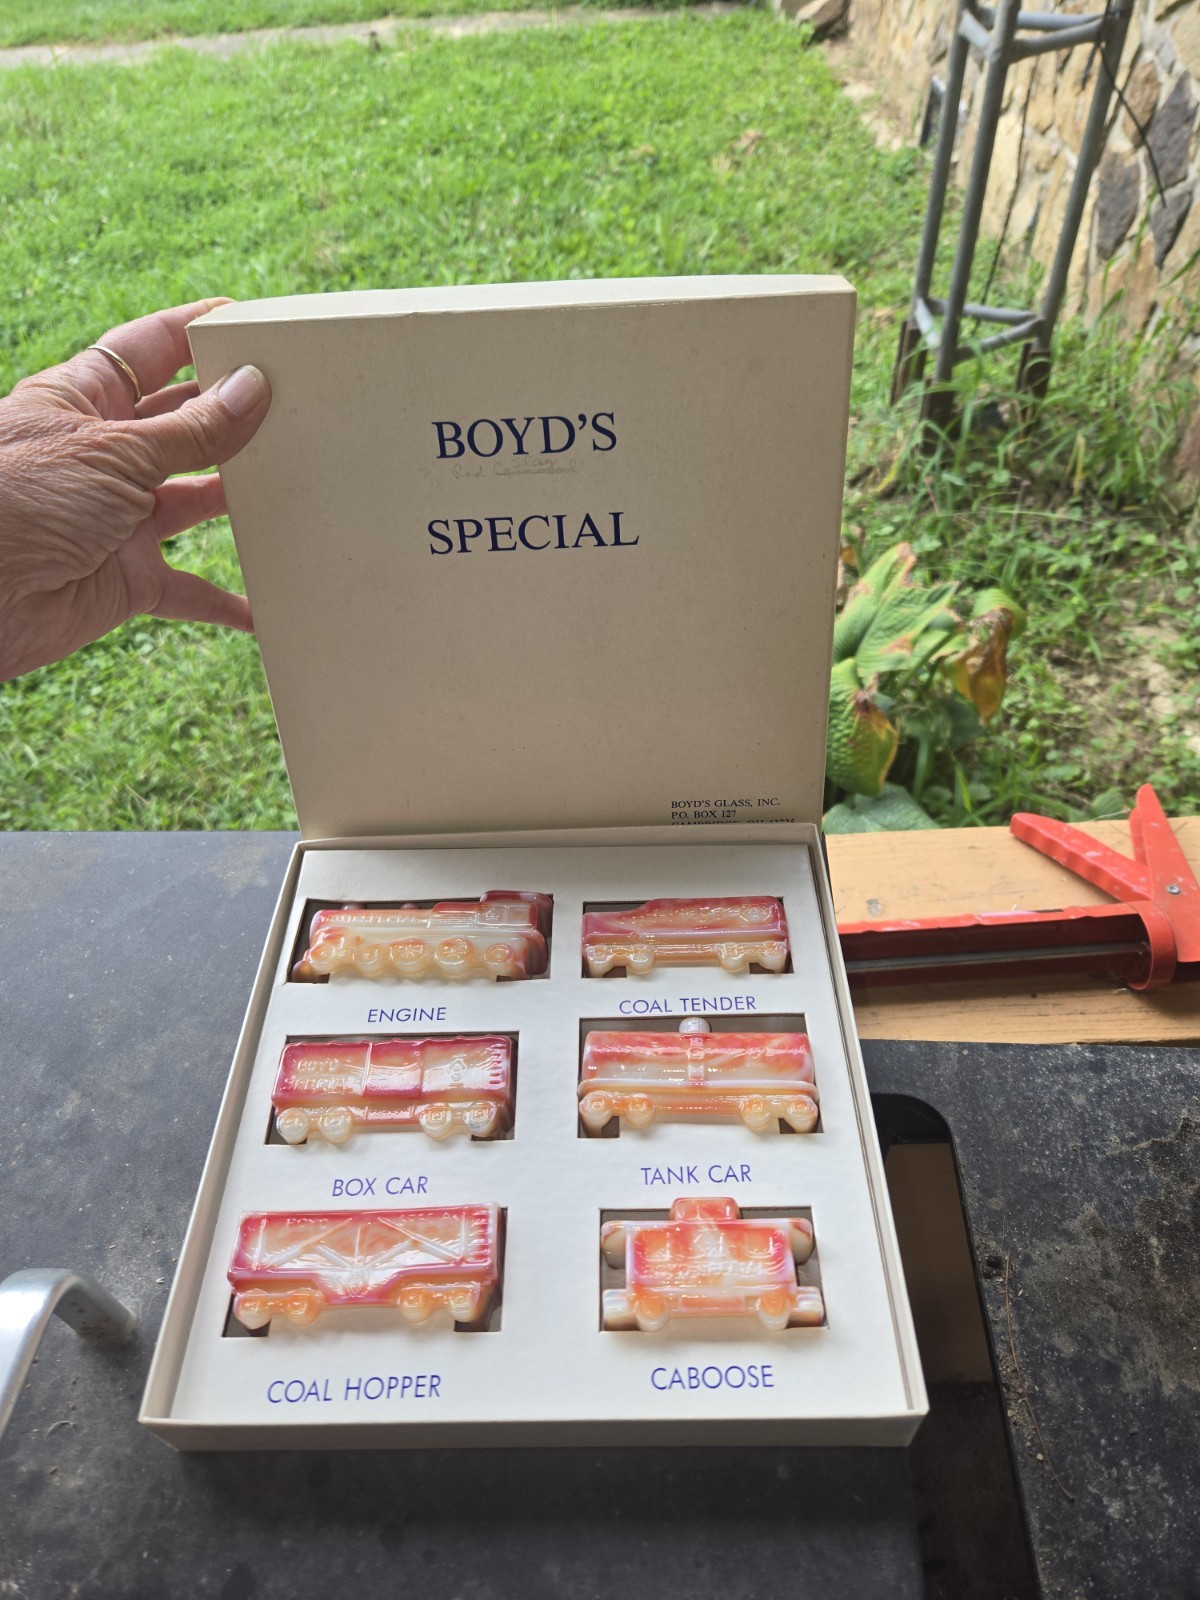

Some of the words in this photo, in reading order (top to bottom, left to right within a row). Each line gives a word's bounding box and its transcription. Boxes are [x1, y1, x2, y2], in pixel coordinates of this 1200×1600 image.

[431, 411, 617, 458] BOYD'S
[428, 511, 640, 556] SPECIAL
[671, 800, 711, 809] BOYD'S
[714, 799, 753, 808] GLASS,
[757, 798, 781, 807] INC.
[671, 811, 690, 819] P.O.
[694, 810, 718, 819] BOX
[721, 810, 737, 818] 127
[367, 1006, 447, 1023] ENGINE
[618, 999, 673, 1015] COAL
[679, 996, 757, 1012] TENDER
[332, 1177, 377, 1197] BOX
[385, 1175, 428, 1195] CAR
[640, 1166, 700, 1186] TANK
[707, 1164, 752, 1184] CAR
[650, 1364, 775, 1391] CABOOSE
[267, 1378, 333, 1404] COAL
[344, 1374, 442, 1401] HOPPER
